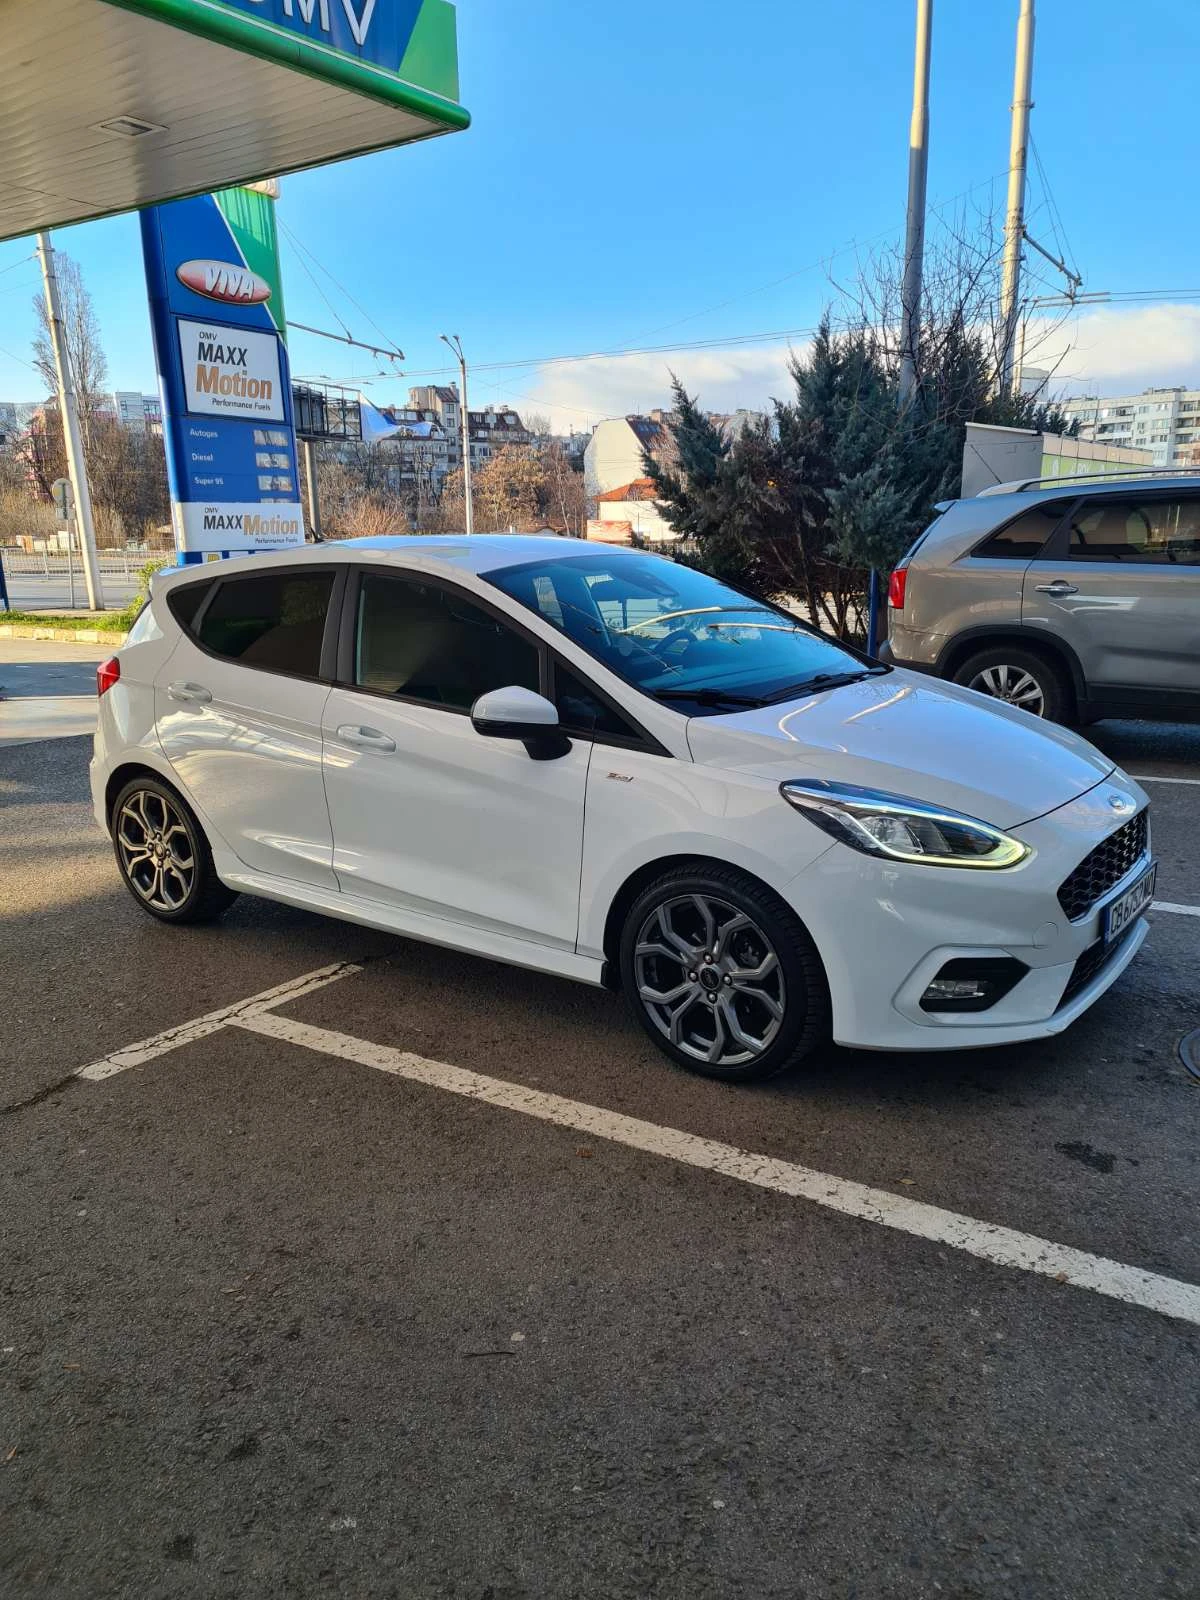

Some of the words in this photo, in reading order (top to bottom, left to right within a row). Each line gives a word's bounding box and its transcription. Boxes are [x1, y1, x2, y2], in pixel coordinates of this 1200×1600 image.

[205, 267, 255, 301] VIVA
[199, 331, 217, 341] OMV
[198, 341, 248, 367] MAXX
[196, 363, 272, 400] Motion
[211, 397, 253, 410] Performance
[254, 401, 271, 411] Fuels
[192, 452, 213, 461] Diesel
[194, 476, 214, 486] Super
[204, 506, 219, 514] OMV
